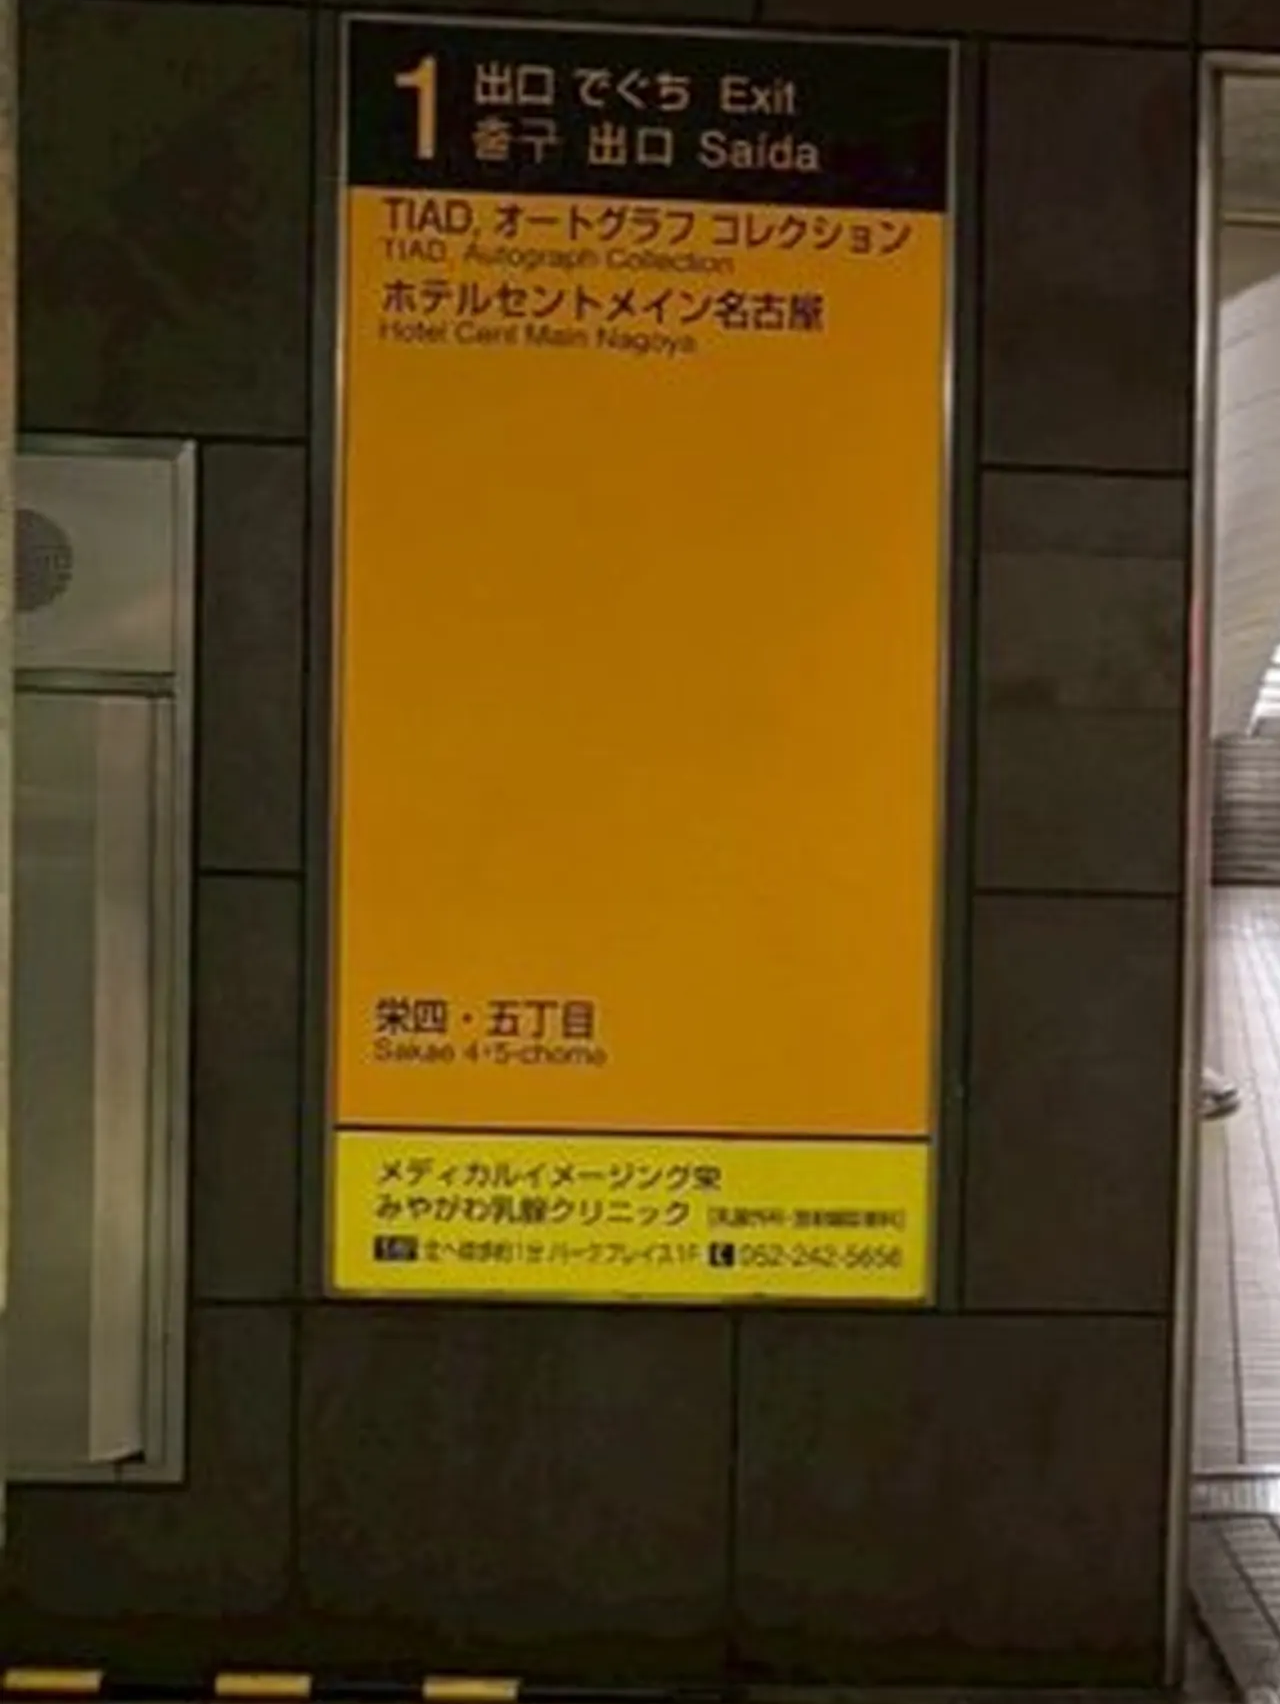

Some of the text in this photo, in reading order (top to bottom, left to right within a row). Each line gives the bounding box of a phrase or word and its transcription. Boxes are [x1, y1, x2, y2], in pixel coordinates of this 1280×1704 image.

[394, 55, 437, 160] 1
[475, 61, 797, 115] 出口 でぐち Exit
[588, 121, 674, 167] 出口
[495, 201, 695, 245] オートグラフ
[712, 211, 912, 255] コレクション
[382, 278, 826, 331] ホテルセントメイン名古屋
[375, 996, 595, 1040] 栄四・五丁目
